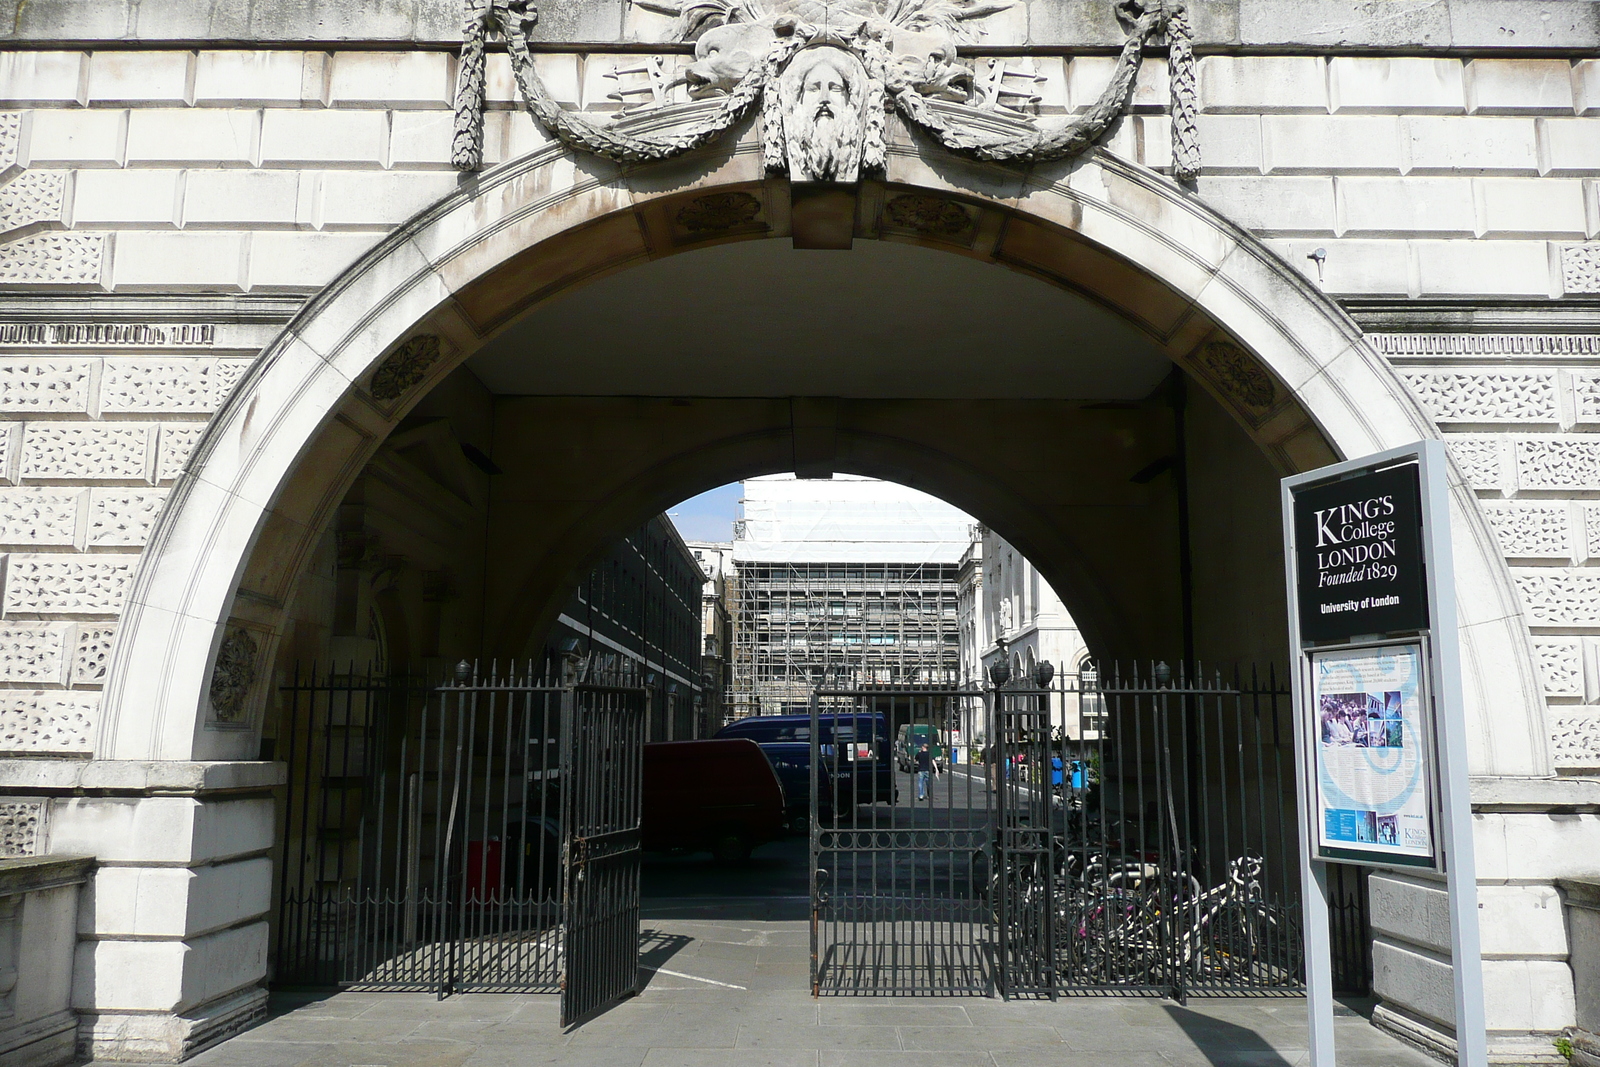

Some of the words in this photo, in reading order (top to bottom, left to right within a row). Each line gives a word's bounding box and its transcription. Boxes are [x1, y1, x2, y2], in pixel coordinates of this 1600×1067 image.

[1314, 495, 1394, 548] KING'S
[1341, 520, 1395, 541] College
[1317, 539, 1396, 570] LONDON
[1318, 564, 1366, 588] Founded
[1367, 562, 1398, 582] 1829
[1320, 600, 1359, 614] University
[1361, 597, 1370, 609] of
[1371, 594, 1400, 608] London
